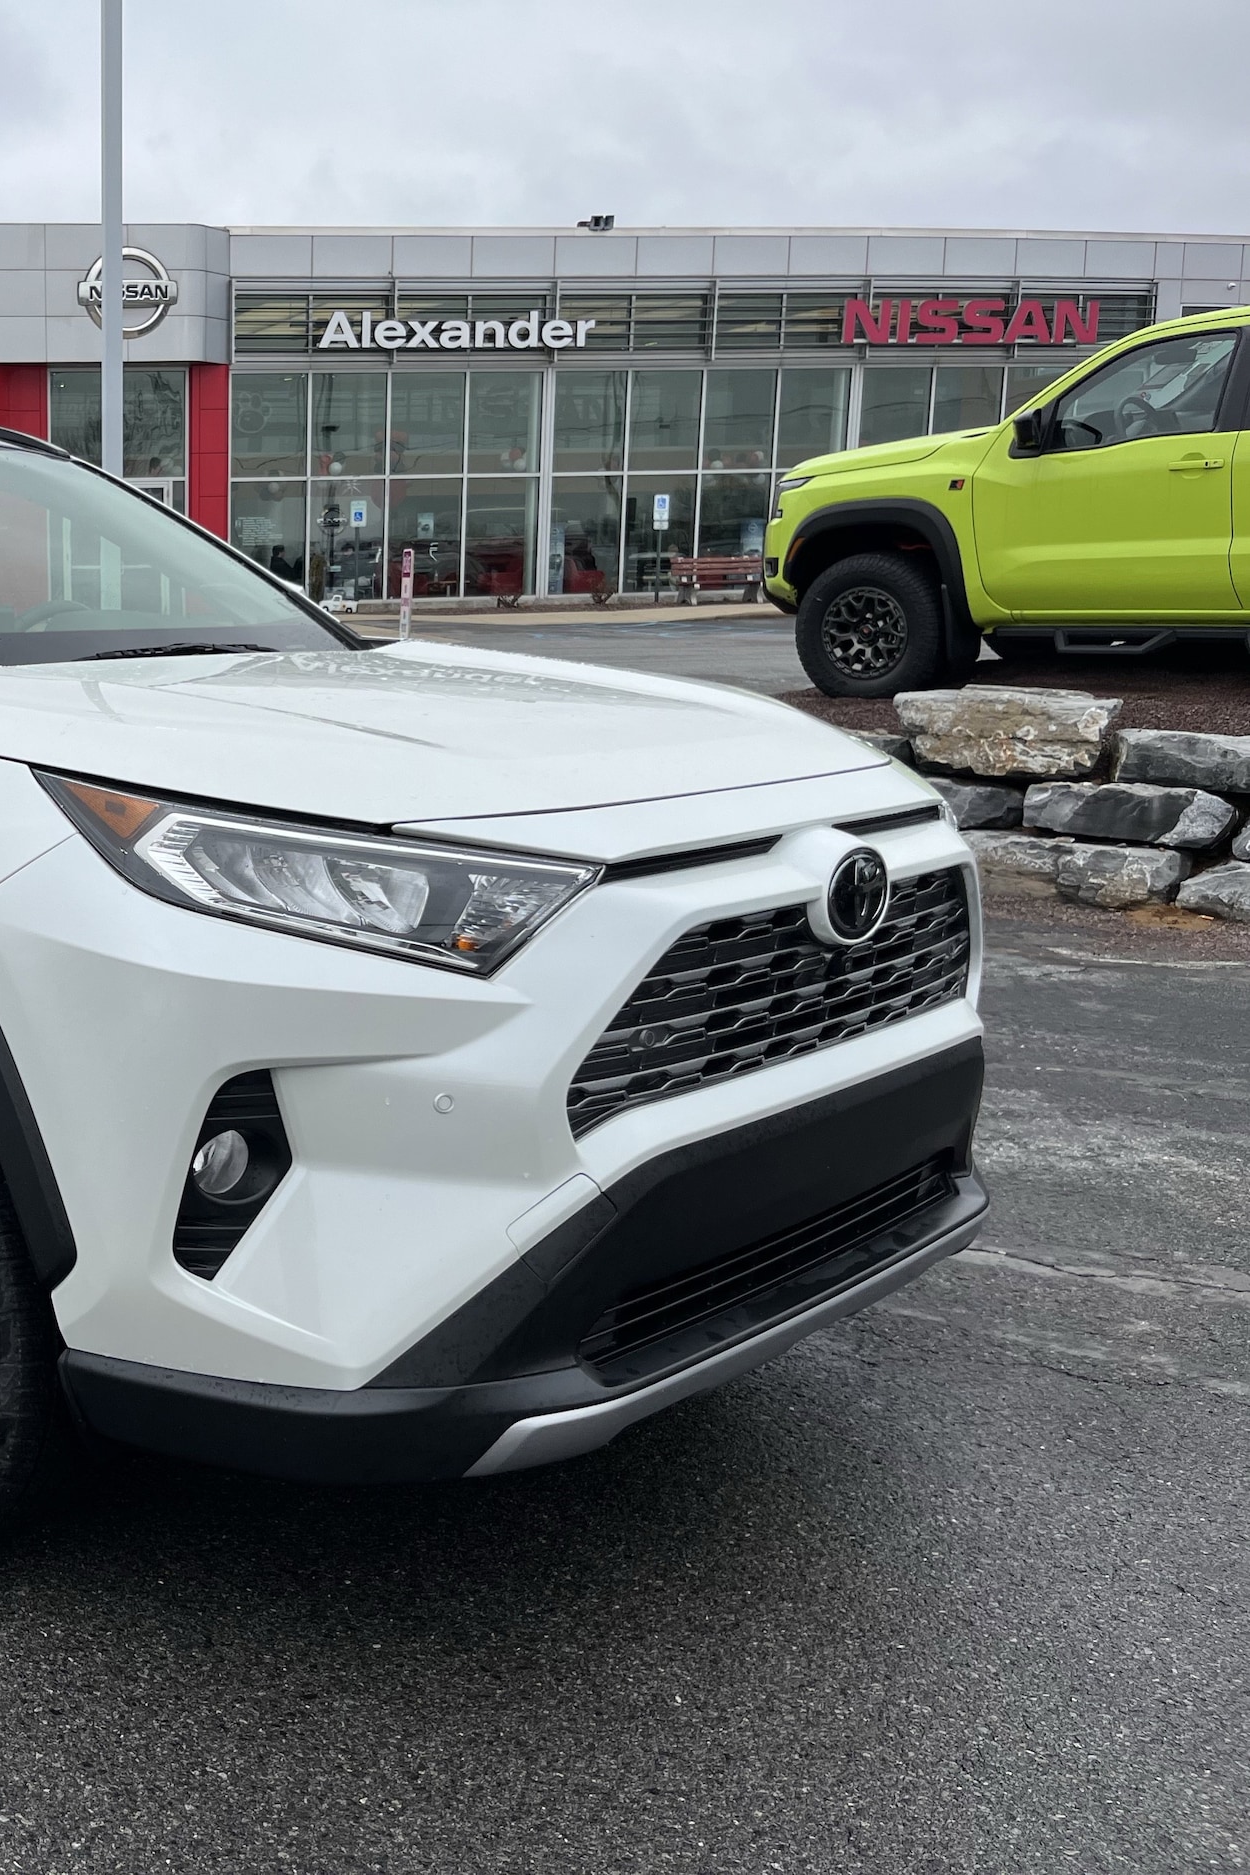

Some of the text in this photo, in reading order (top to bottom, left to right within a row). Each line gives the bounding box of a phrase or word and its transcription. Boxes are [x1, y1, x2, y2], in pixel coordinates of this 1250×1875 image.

[89, 284, 169, 300] NSAN
[318, 310, 596, 350] Alexander
[842, 299, 1100, 344] NISSAN
